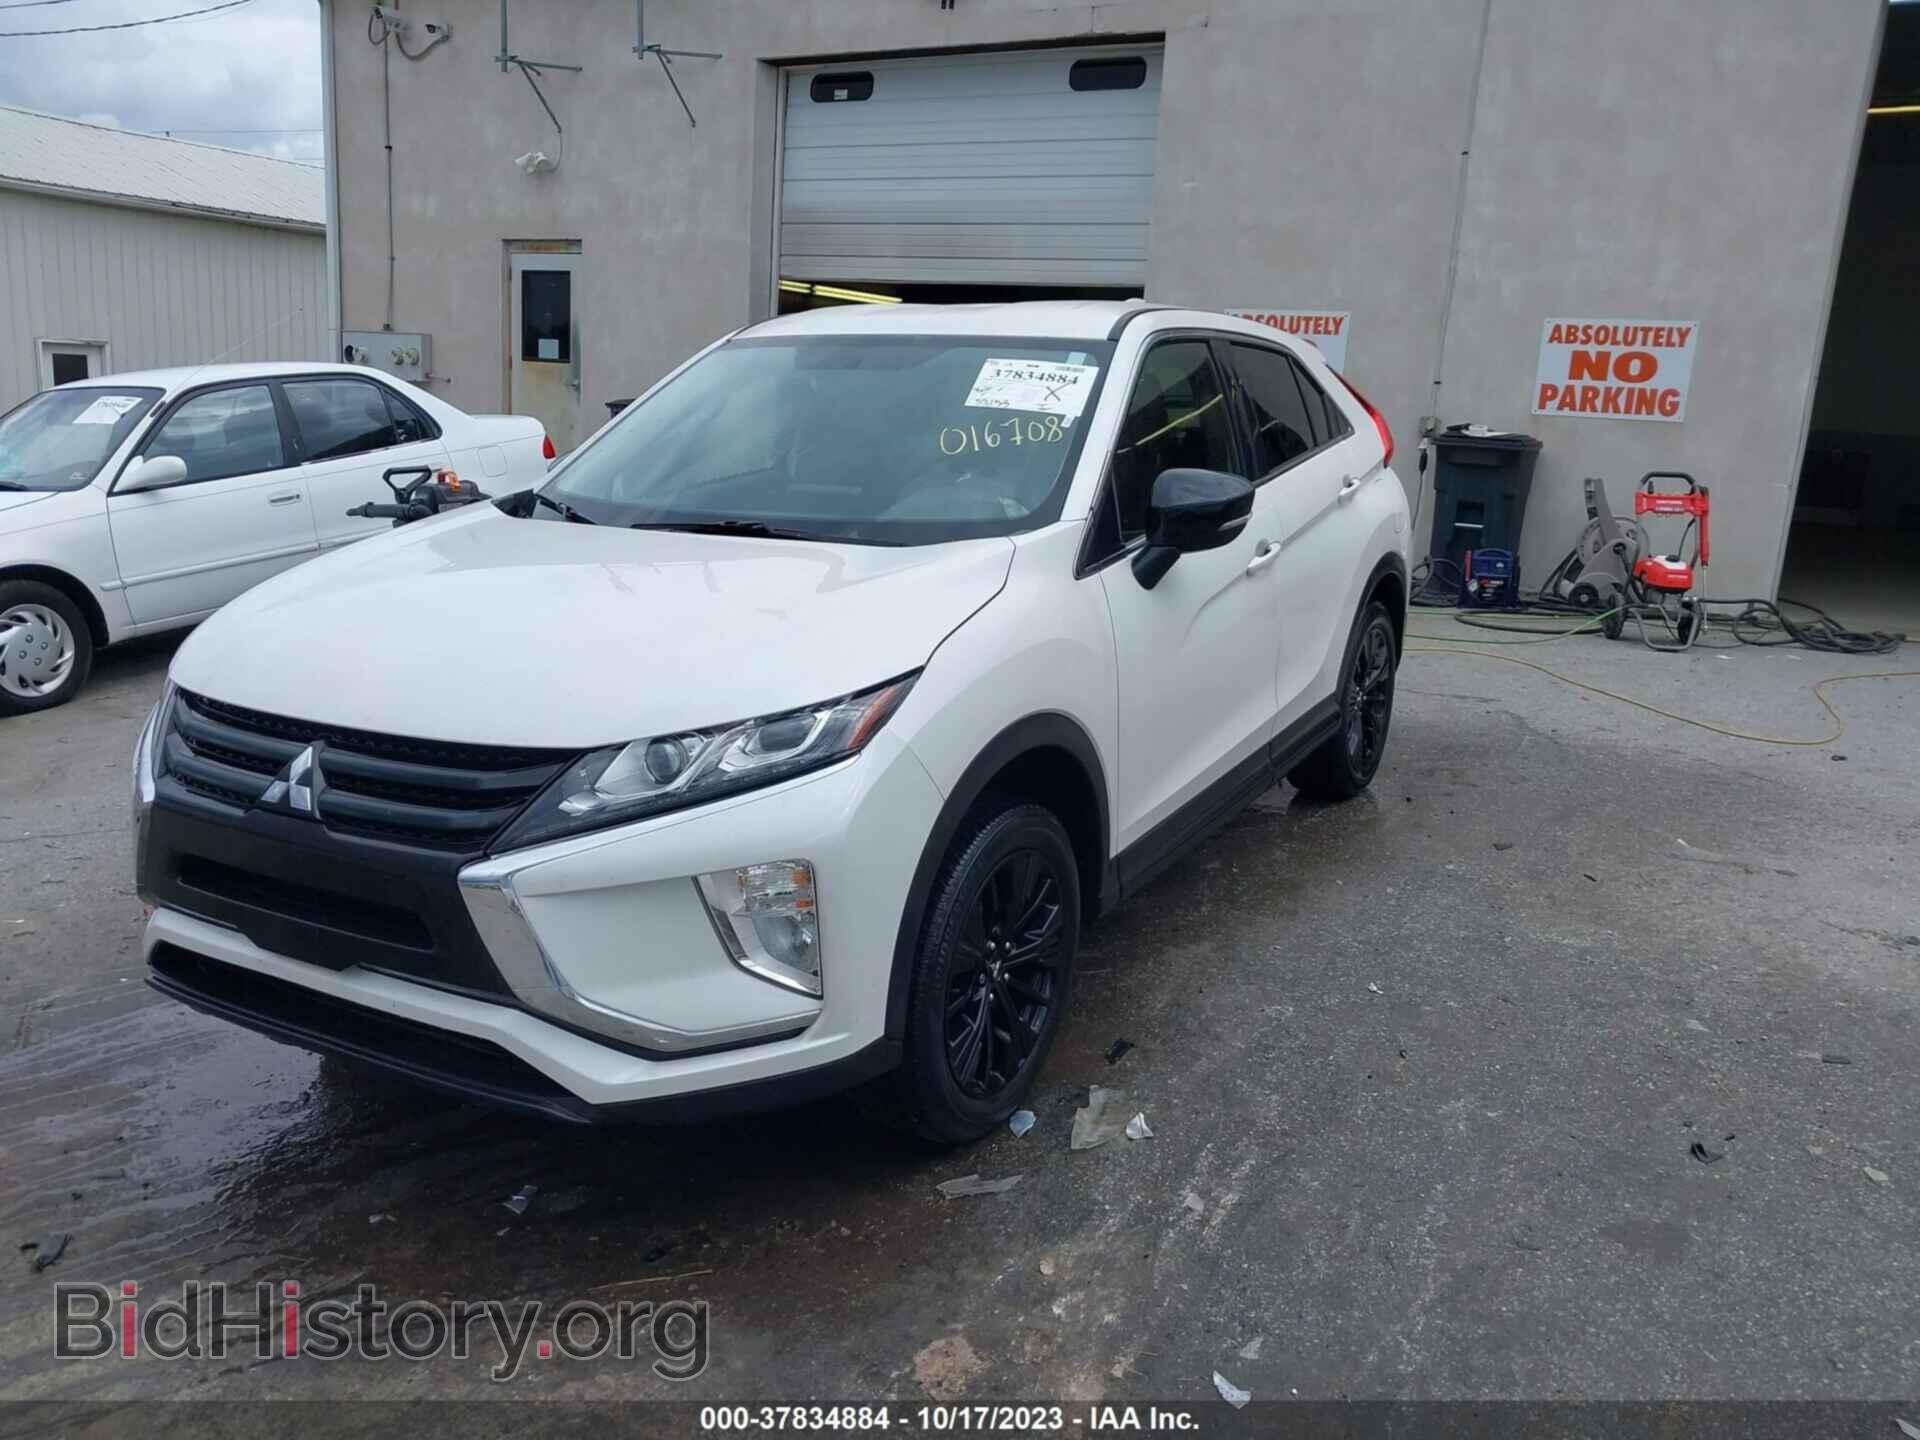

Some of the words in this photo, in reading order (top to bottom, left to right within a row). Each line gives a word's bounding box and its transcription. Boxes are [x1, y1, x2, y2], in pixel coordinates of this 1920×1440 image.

[1548, 323, 1692, 347] ABSOLUTELY
[1568, 350, 1658, 383] NO
[1538, 383, 1681, 417] PARKING
[940, 416, 1063, 455] 016708
